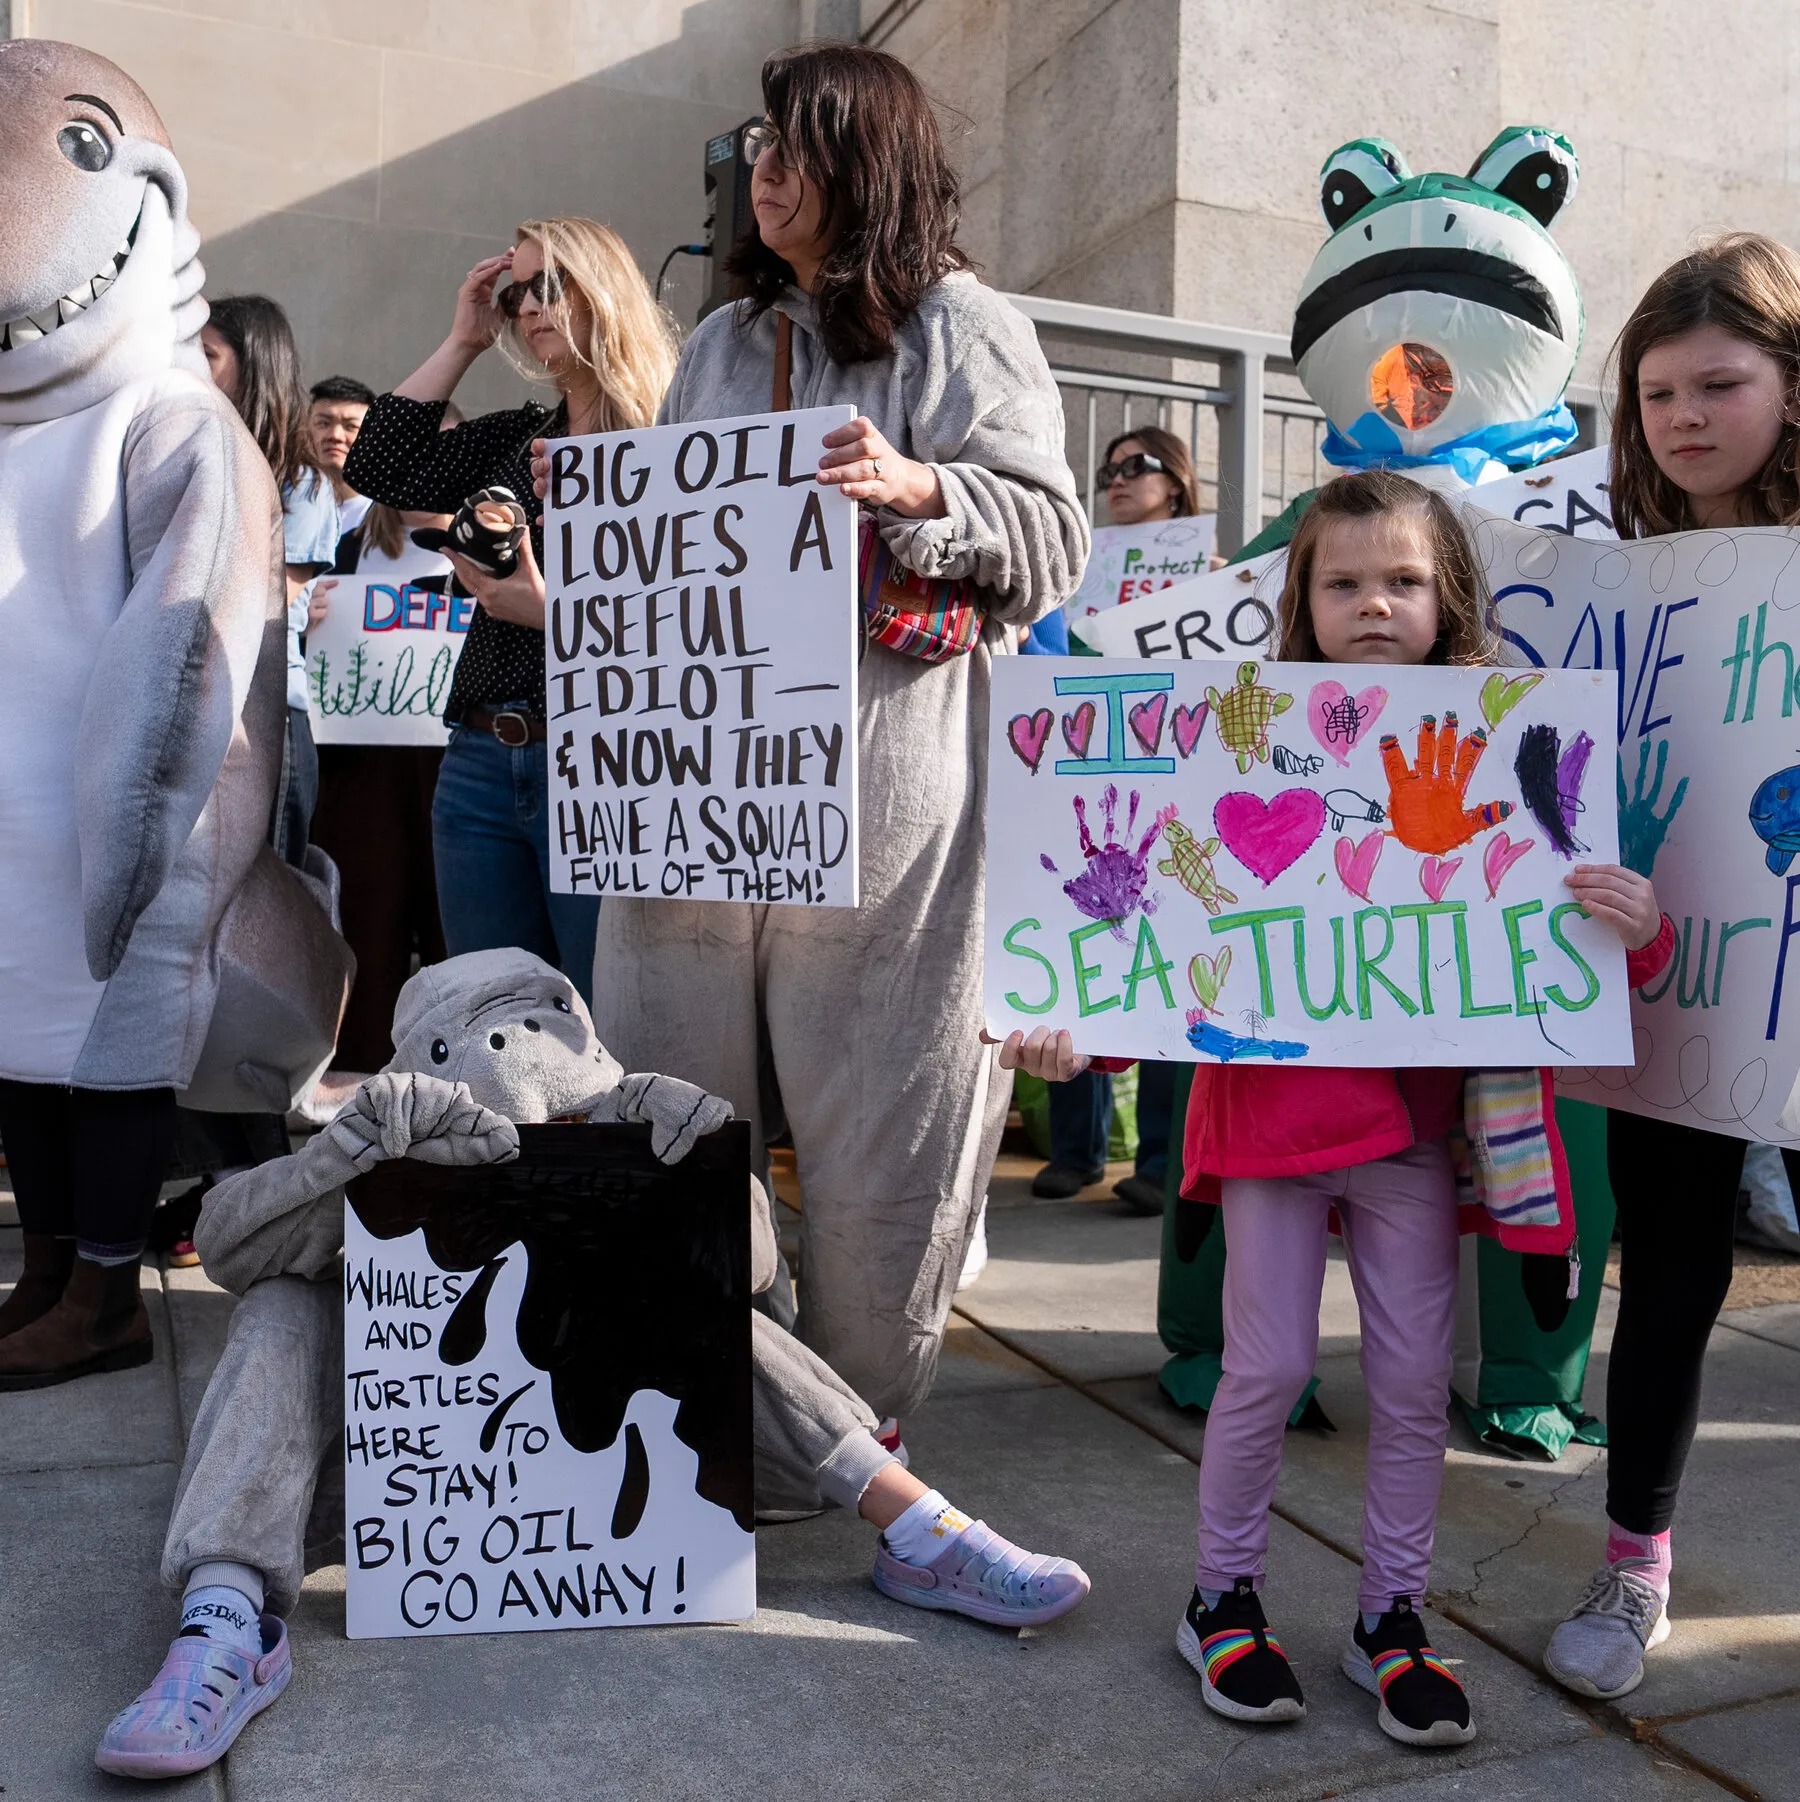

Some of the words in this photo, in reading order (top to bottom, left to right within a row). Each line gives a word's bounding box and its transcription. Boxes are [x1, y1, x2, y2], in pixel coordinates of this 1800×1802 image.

[551, 440, 651, 510] BIG
[674, 423, 818, 494] OIL
[561, 503, 748, 587] LOVES
[789, 490, 833, 572] A
[1123, 548, 1206, 575] Protect
[552, 584, 770, 663] USEFUL
[311, 640, 451, 719] Wild
[1722, 601, 1800, 724] th
[556, 730, 577, 790] &
[591, 725, 712, 789] NOW
[728, 723, 843, 789] THEY
[1054, 672, 1176, 776] I
[558, 796, 652, 857] HAVE
[665, 797, 690, 857] A
[700, 795, 848, 869] SQUAD
[570, 857, 649, 895] FULL
[660, 862, 705, 897] OF
[717, 865, 826, 903] THEM!
[1003, 913, 1178, 1019] SEA
[1208, 899, 1601, 1022] TURTLES
[346, 1257, 462, 1312] WHALES
[365, 1320, 432, 1351] AND
[348, 1369, 500, 1412] TURTLES
[346, 1423, 443, 1467] HERE
[505, 1422, 549, 1458] TO
[384, 1461, 518, 1507] STAY!
[352, 1516, 460, 1569] BIG
[480, 1506, 594, 1564] OIL
[400, 1569, 478, 1629] GO
